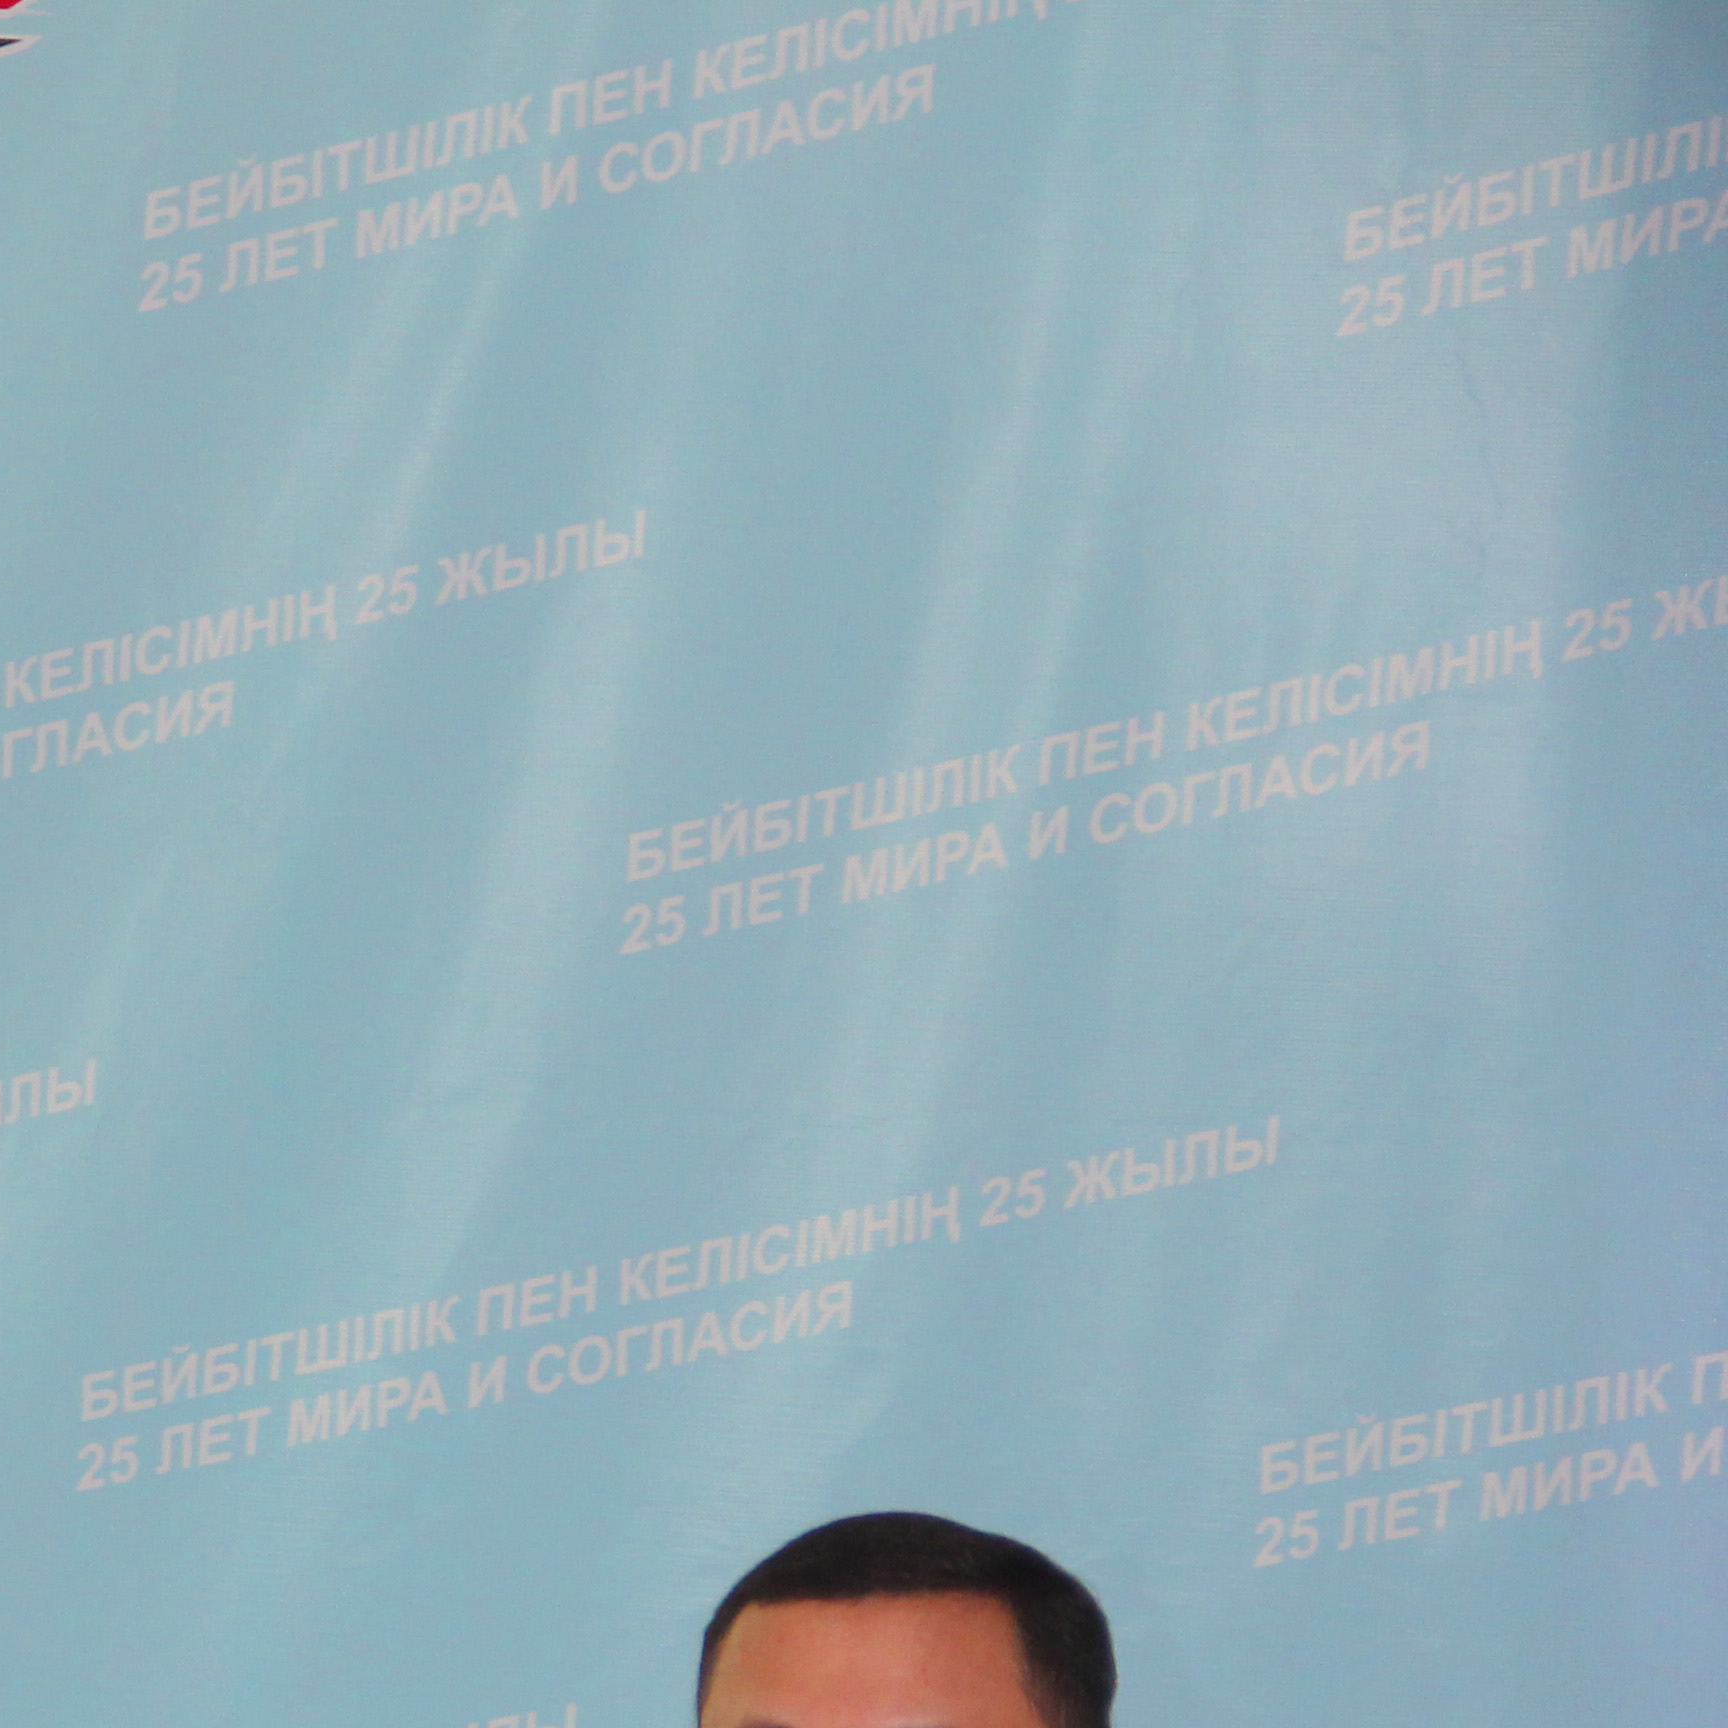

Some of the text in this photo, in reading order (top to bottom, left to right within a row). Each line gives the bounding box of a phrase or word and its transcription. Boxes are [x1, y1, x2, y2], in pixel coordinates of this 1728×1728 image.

[138, 64, 937, 312] 25 ЛЕТ МИРА И СОГЛАСИЯ
[142, 96, 532, 240] БЕЙБІТШІЛІК
[547, 60, 673, 137] ПЕН
[1343, 116, 1728, 261] БЕЙБІТШІЛІ
[1337, 275, 1405, 337] 25
[1421, 236, 1549, 316] ЛЕТ
[3, 582, 341, 708] КЕЛІСІМНІҢ
[352, 564, 419, 626] 25
[436, 508, 651, 605] ЖЫЛЫ
[619, 721, 1431, 955] 25 ЛЕТ МИРА И СОГЛАСИЯ
[625, 744, 1023, 883] БЕЙБІТШІЛІК
[1036, 712, 1166, 785] ПЕН
[1184, 618, 1544, 750] КЕЛІСІМНІҢ
[1563, 598, 1633, 662] 25
[80, 1115, 1281, 1421] БЕЙБІТШІЛІК ПЕН КЕЛІСІМНІҢ 25 ЖЫЛЫ
[76, 1279, 854, 1493] 25 ЛЕТ МИРА И СОГЛАСИЯ
[1258, 1363, 1672, 1495] БЕЙБІТШІЛІК
[1252, 1426, 1728, 1569] 25 ЛЕТ МИРА И
